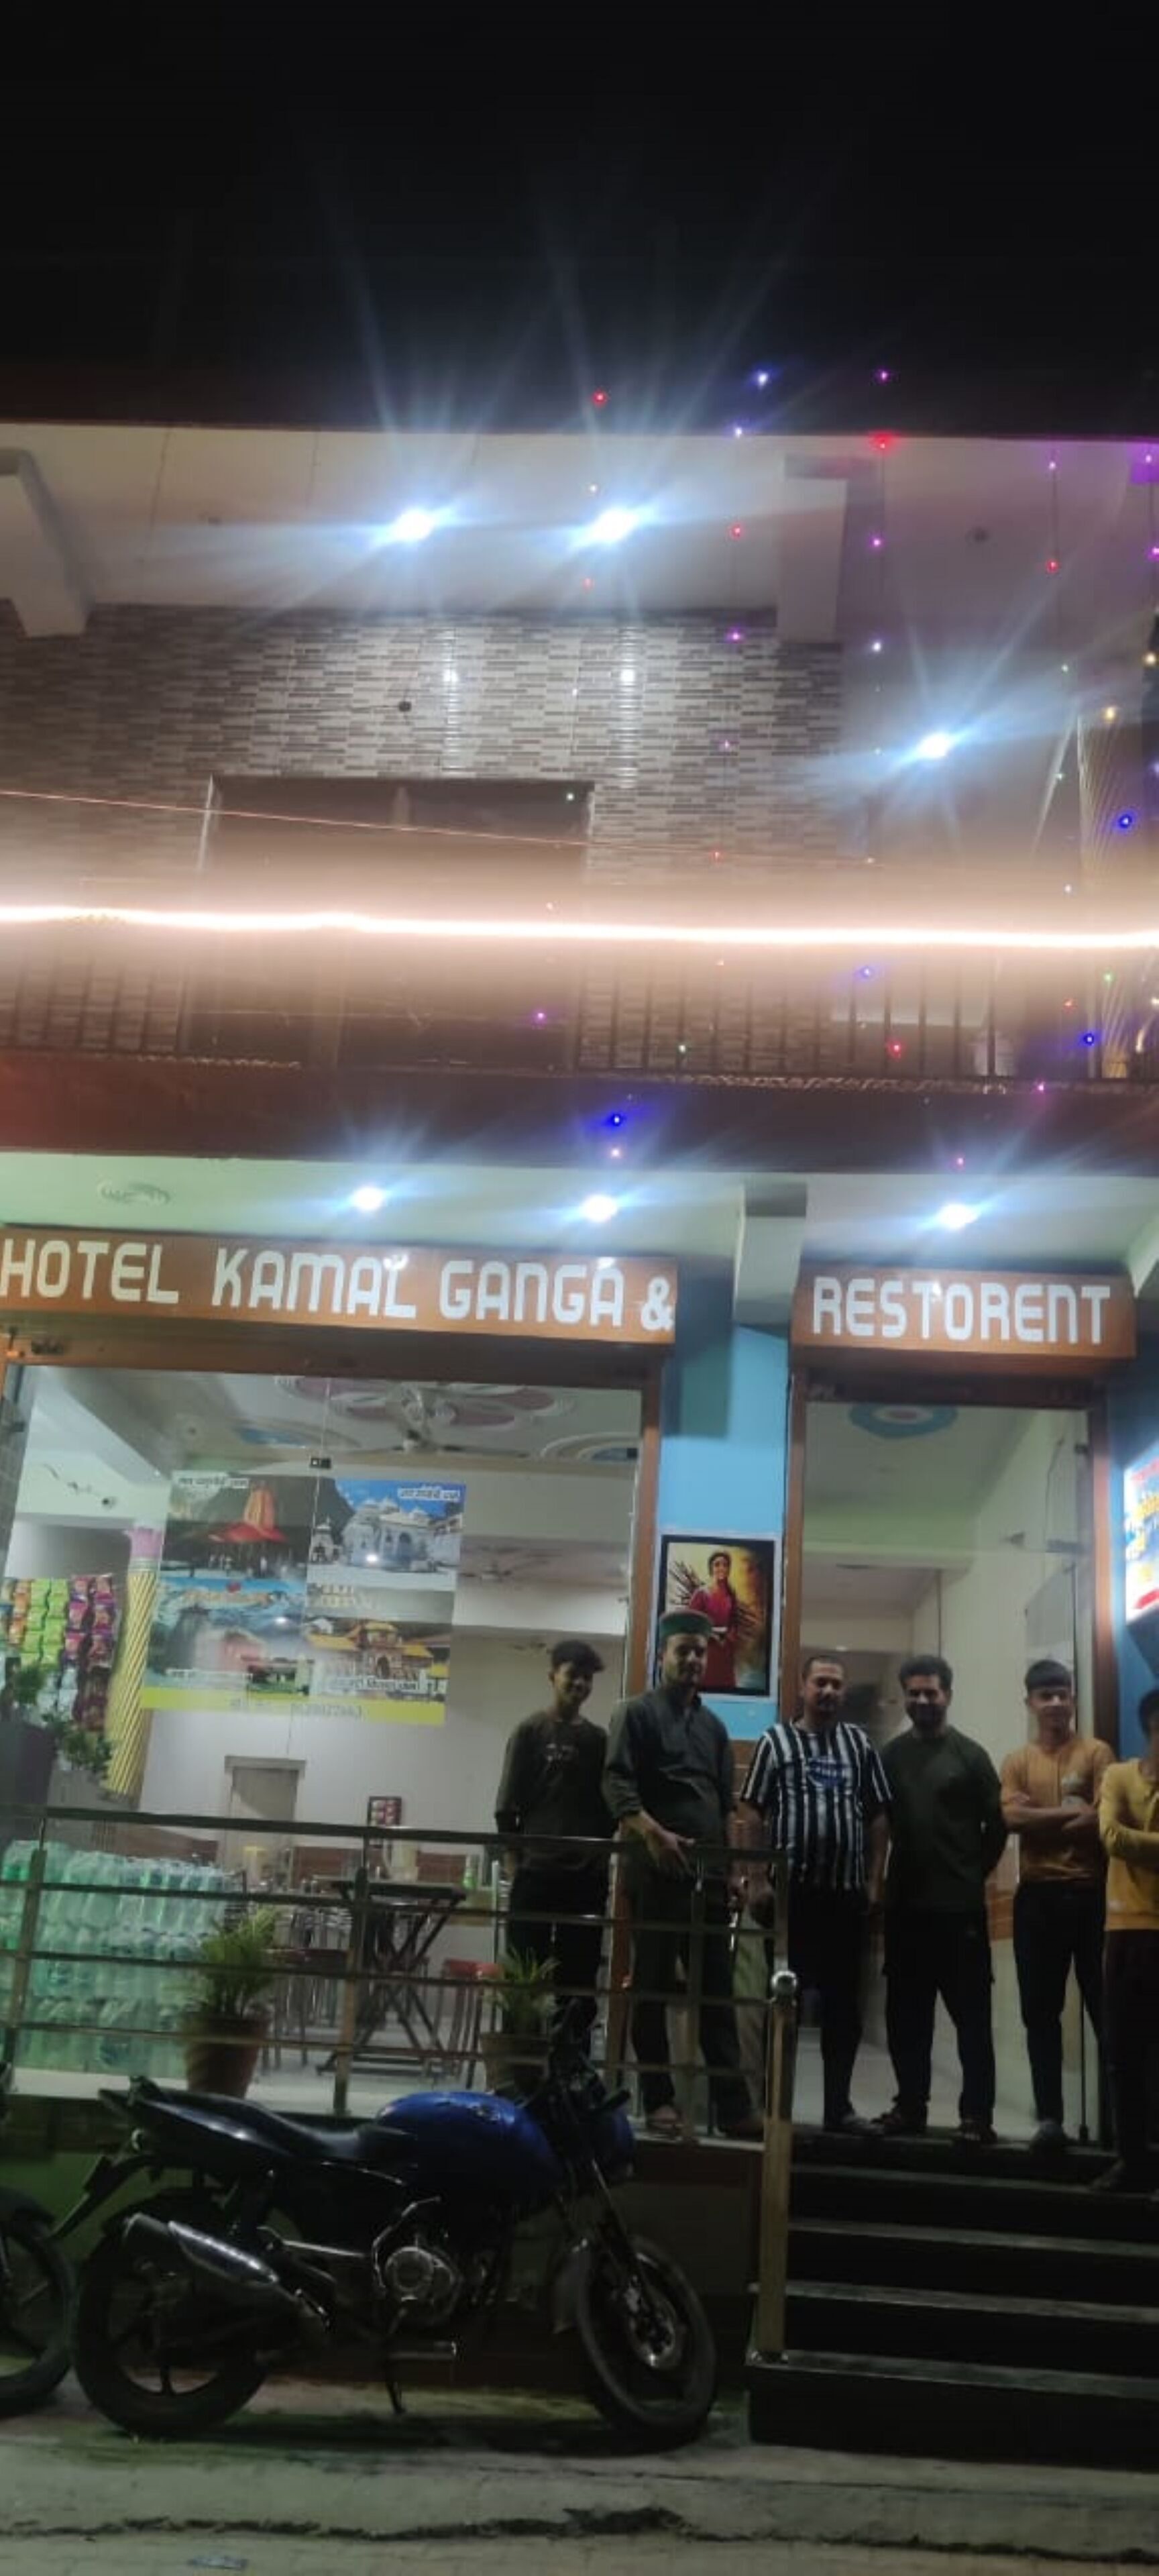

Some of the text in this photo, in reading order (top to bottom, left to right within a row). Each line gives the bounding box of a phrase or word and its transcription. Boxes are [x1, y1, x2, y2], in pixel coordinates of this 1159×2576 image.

[0, 1239, 673, 1331] HOTEL KAMAL GANGA &
[813, 1277, 1110, 1344] RESTORENT
